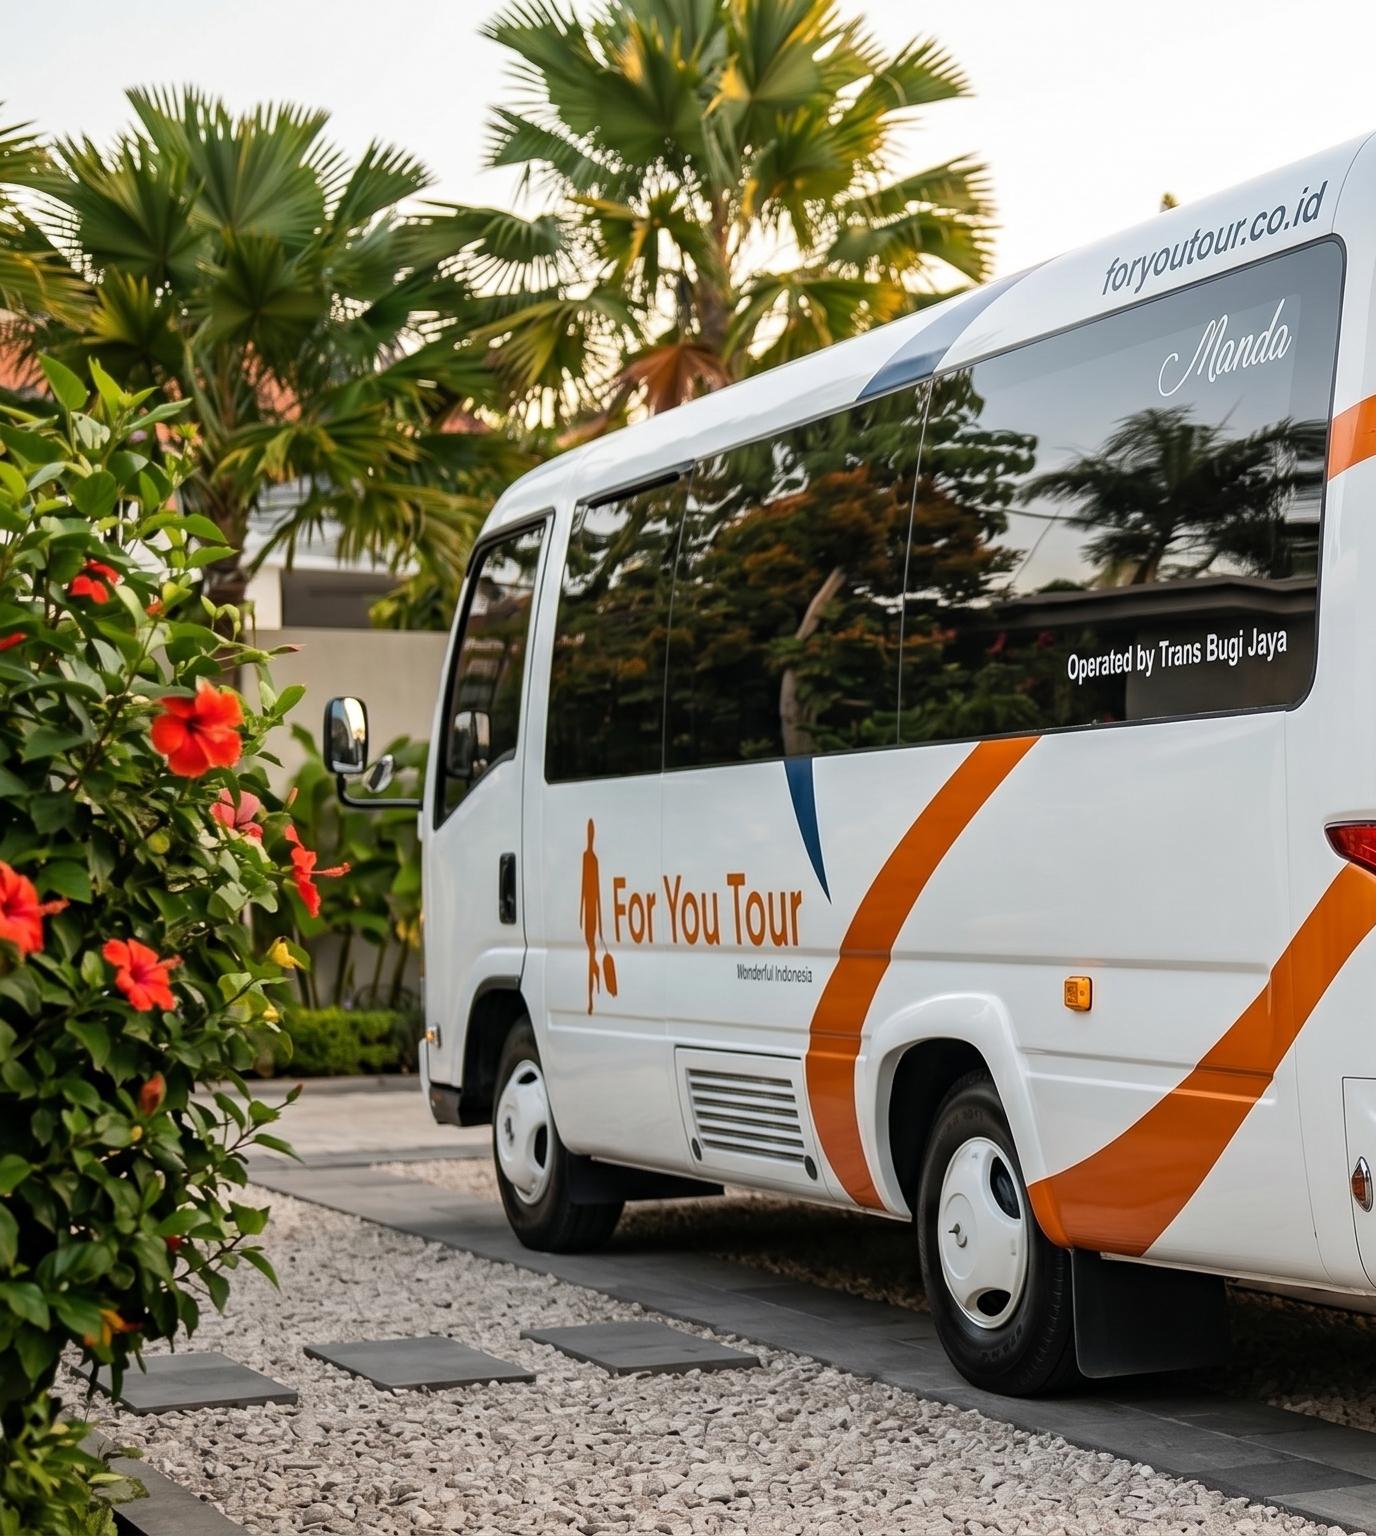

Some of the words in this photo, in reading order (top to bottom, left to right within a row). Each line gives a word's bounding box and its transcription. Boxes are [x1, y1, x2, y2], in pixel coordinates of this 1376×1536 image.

[1101, 179, 1328, 295] foryoutour.co.id
[1158, 298, 1291, 397] Manda
[1067, 645, 1132, 685] Operated
[1137, 644, 1155, 677] by
[1159, 640, 1201, 668] Trans
[1206, 629, 1244, 667] Bugi
[1248, 627, 1288, 662] Jaya
[612, 876, 656, 944] For
[663, 874, 721, 946] You
[726, 872, 803, 947] Tour
[736, 963, 774, 981] Wonderful
[775, 965, 813, 983] Indonesia
